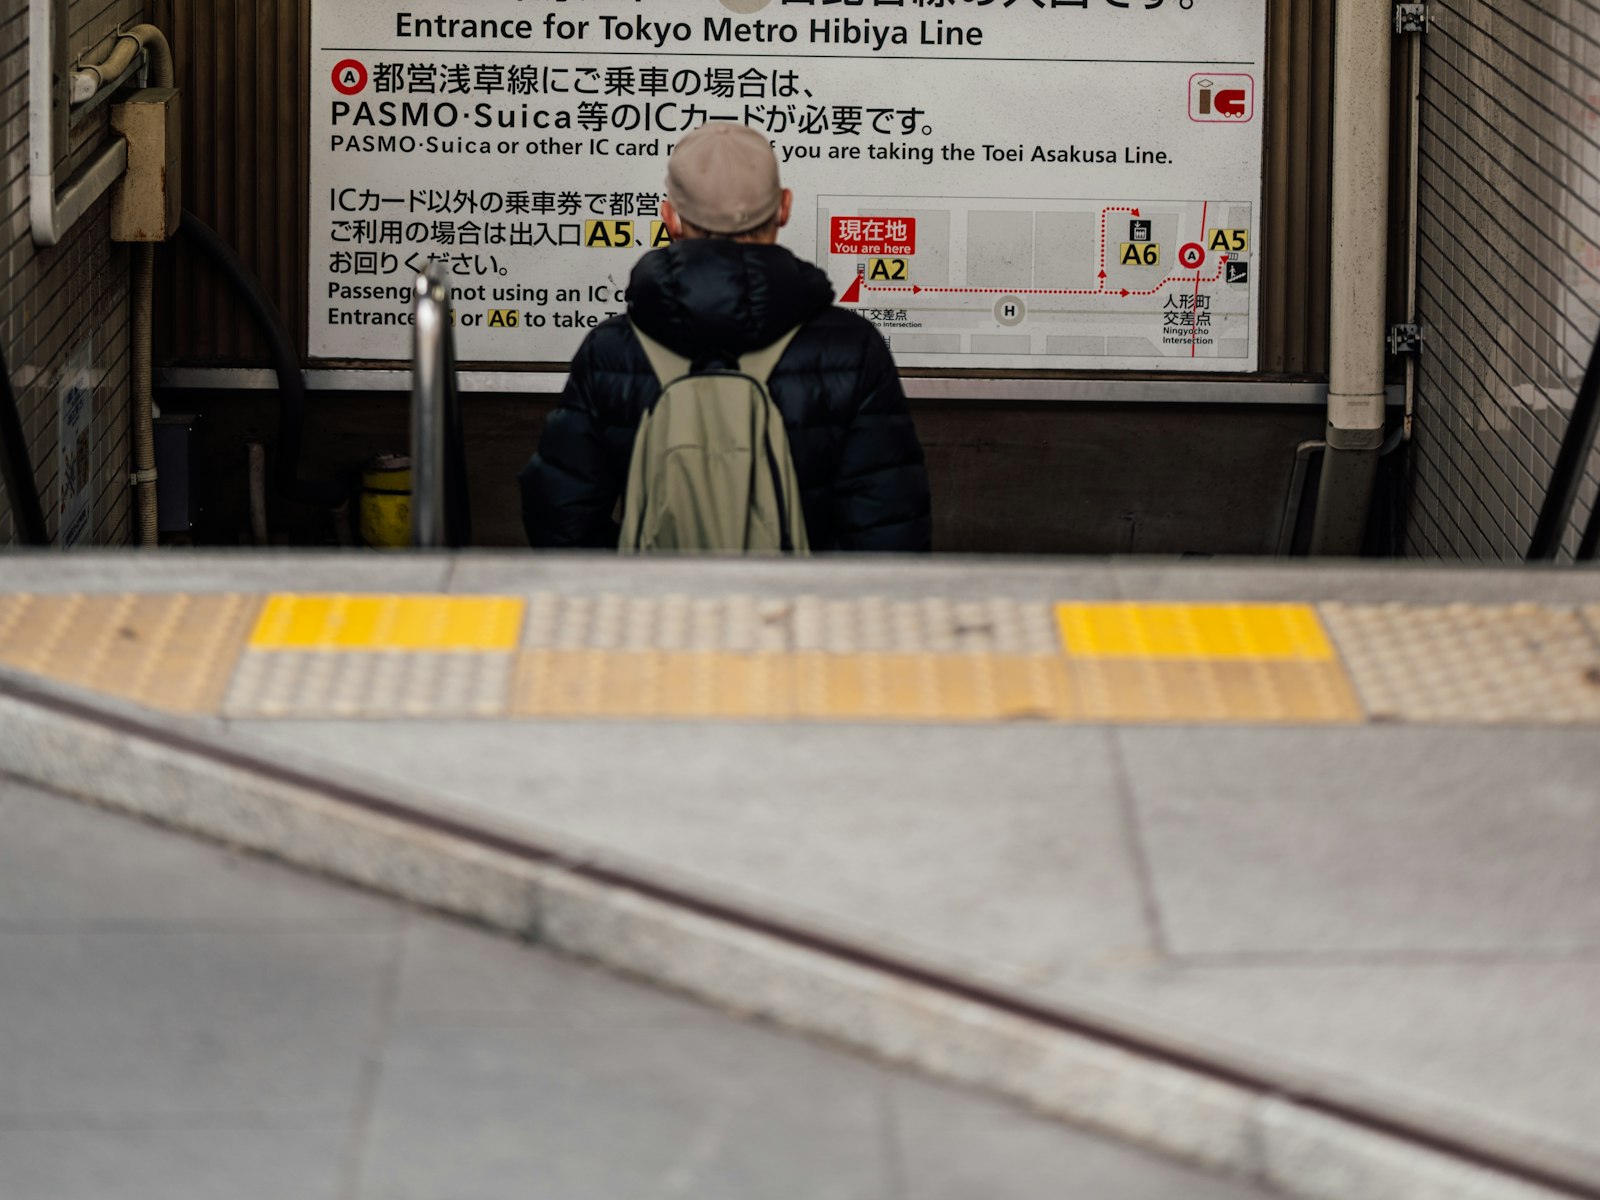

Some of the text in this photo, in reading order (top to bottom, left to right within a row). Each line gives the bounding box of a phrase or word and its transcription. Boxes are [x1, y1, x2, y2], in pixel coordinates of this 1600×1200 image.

[396, 13, 983, 50] Entrance for Tokyo Metro Hibiya Line
[343, 70, 356, 84] A
[373, 63, 813, 99] 都営浅草線にご乗車の場合は、
[497, 138, 517, 154] or
[526, 136, 583, 155] other
[589, 139, 609, 156] IC
[615, 138, 659, 156] card
[782, 144, 822, 162] you
[828, 145, 862, 159] are
[868, 142, 935, 164] taking
[941, 143, 976, 161] the
[982, 144, 1024, 162] Toei
[1031, 146, 1118, 164] Asakusa
[1124, 147, 1173, 164] Line.
[330, 188, 669, 217] ICカード以外の乗車券で都営
[330, 220, 672, 247] ご利用の場合は出入口A5、A
[839, 219, 908, 242] 現在地
[1212, 230, 1246, 250] A5
[834, 243, 911, 255] You are here
[1122, 244, 1158, 265] A6
[1187, 250, 1196, 260] A
[869, 259, 907, 279] A2
[328, 282, 416, 304] Passeng
[451, 284, 486, 300] not
[493, 284, 548, 305] using
[556, 288, 580, 301] an
[588, 286, 607, 302] IC
[1163, 294, 1210, 310] 人形町
[461, 314, 483, 326] or
[489, 310, 518, 327] A6
[525, 312, 546, 327] to
[553, 311, 598, 328] take
[846, 308, 907, 320] 丁交差点
[1005, 306, 1014, 317] H
[1163, 310, 1211, 326] 交差点
[1163, 327, 1209, 335] Ningyocho
[1163, 336, 1213, 345] Intersection
